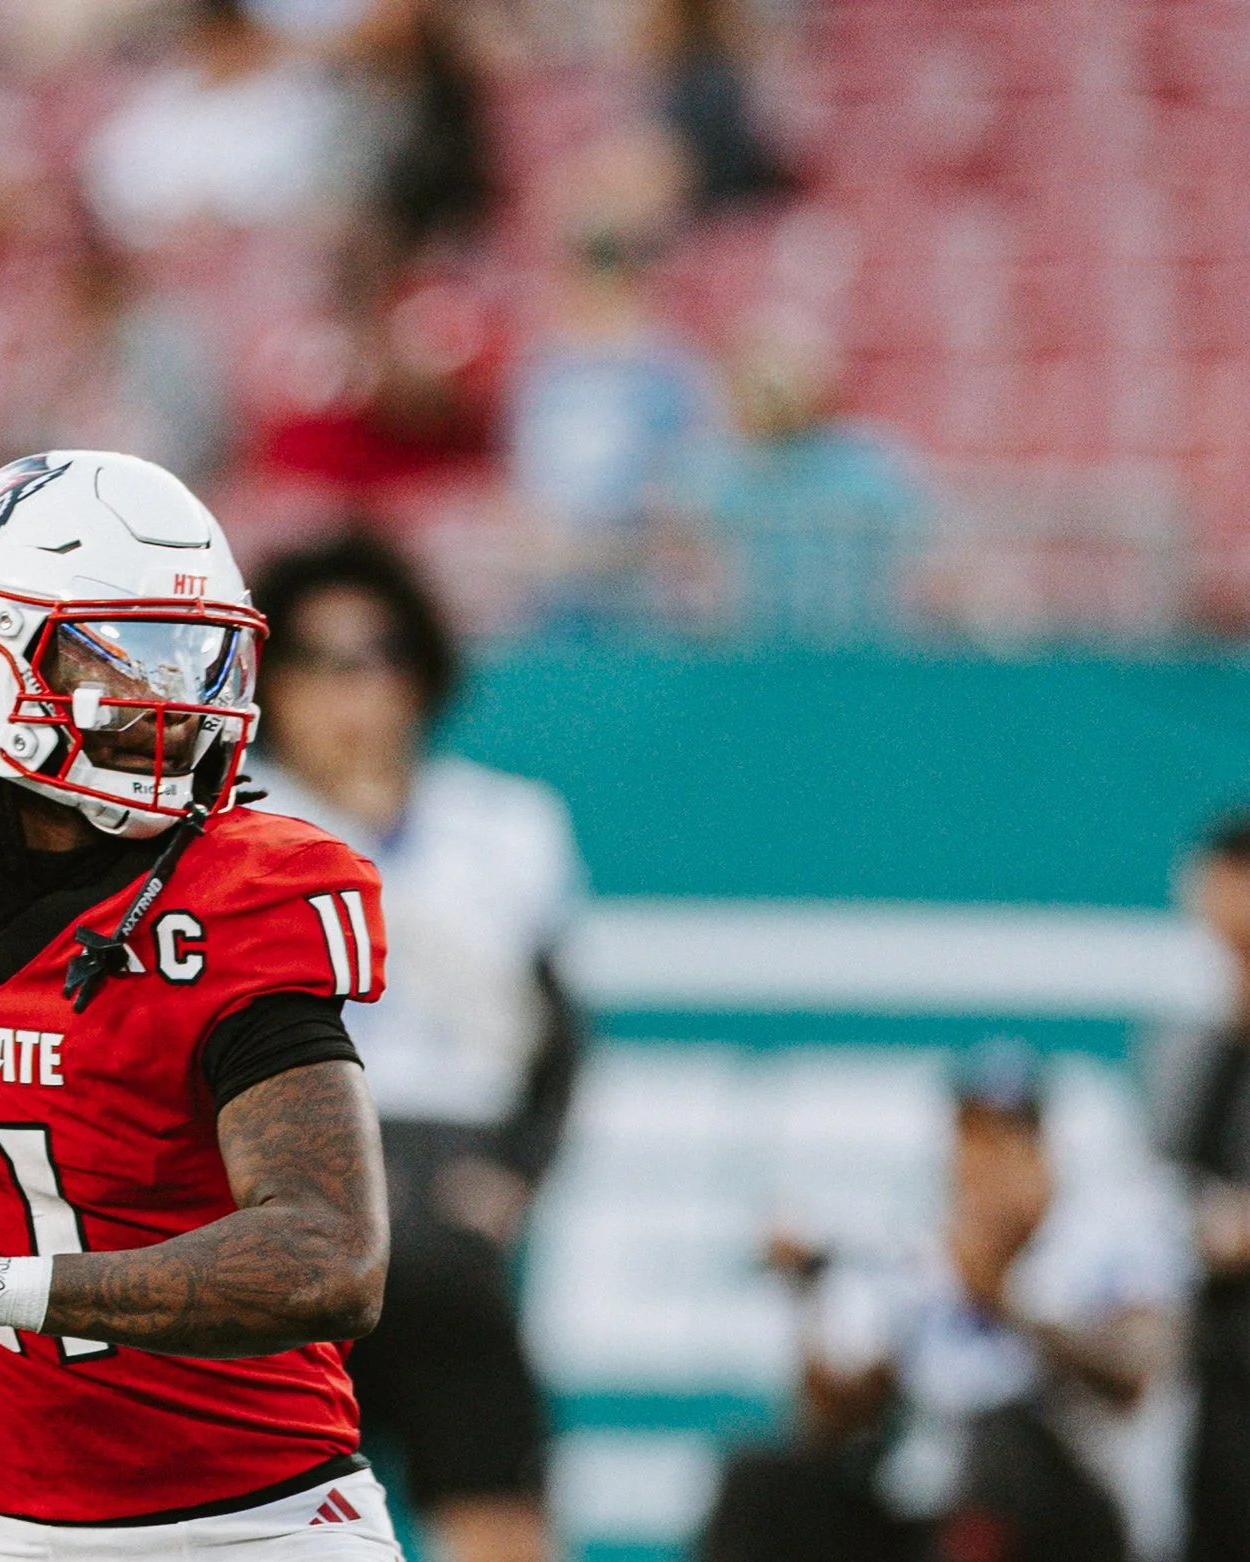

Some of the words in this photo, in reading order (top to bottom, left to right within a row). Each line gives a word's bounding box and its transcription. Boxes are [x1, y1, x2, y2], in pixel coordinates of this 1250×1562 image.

[173, 574, 208, 596] HTT
[121, 877, 163, 936] NXTRND
[154, 911, 205, 982] C
[304, 888, 372, 996] 11
